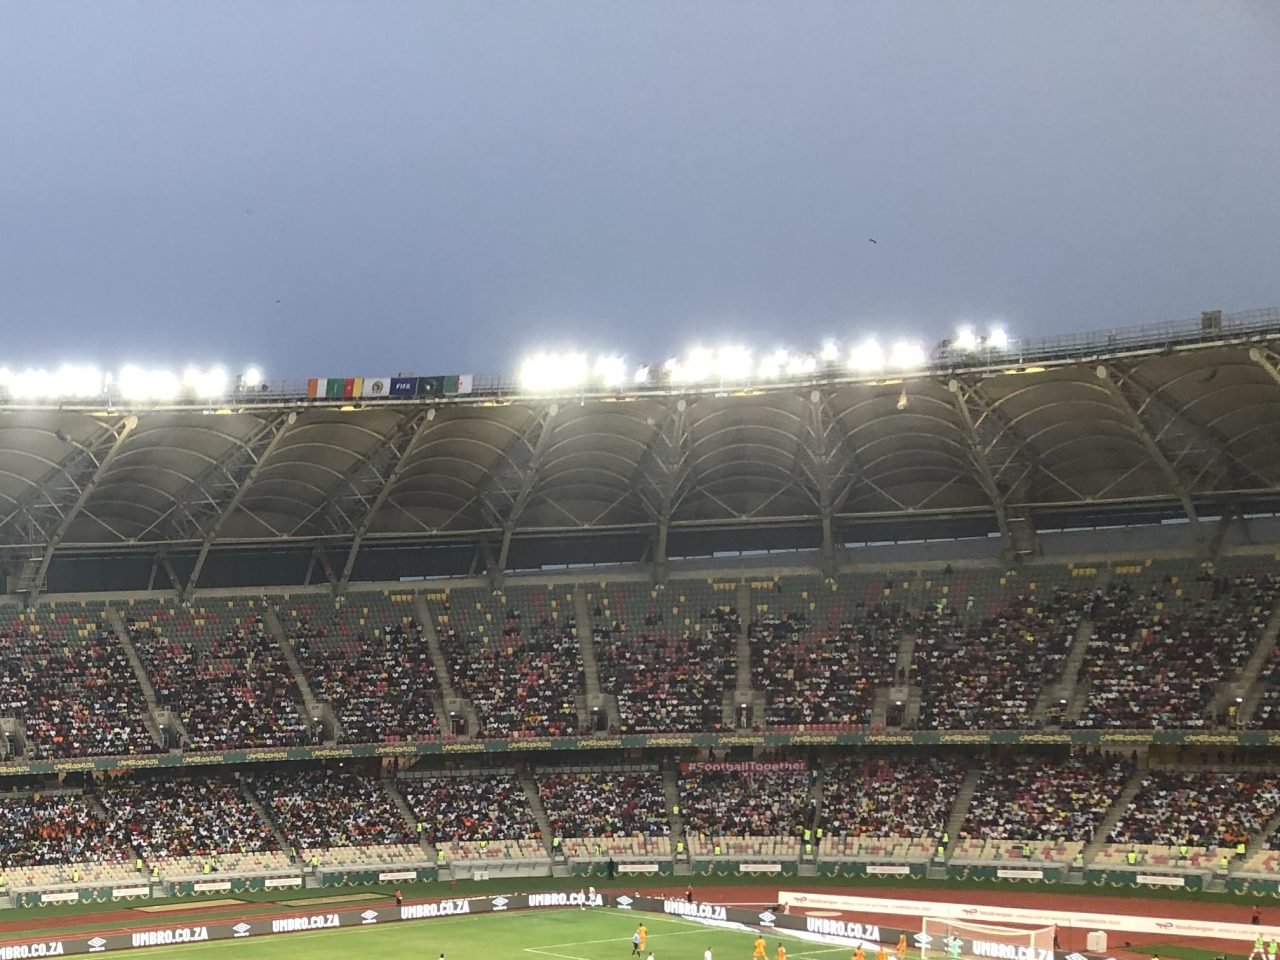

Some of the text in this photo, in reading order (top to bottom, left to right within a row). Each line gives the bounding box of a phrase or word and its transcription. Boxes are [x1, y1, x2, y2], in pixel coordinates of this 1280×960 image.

[401, 900, 470, 919] UMBRO.CO.ZA
[664, 900, 727, 920] UMBRO.CO.ZA
[272, 914, 340, 932] UMBRO.CO.ZA
[807, 917, 880, 941] UMBRO.CO.ZA
[132, 927, 208, 947] UMBRO.CO.ZA
